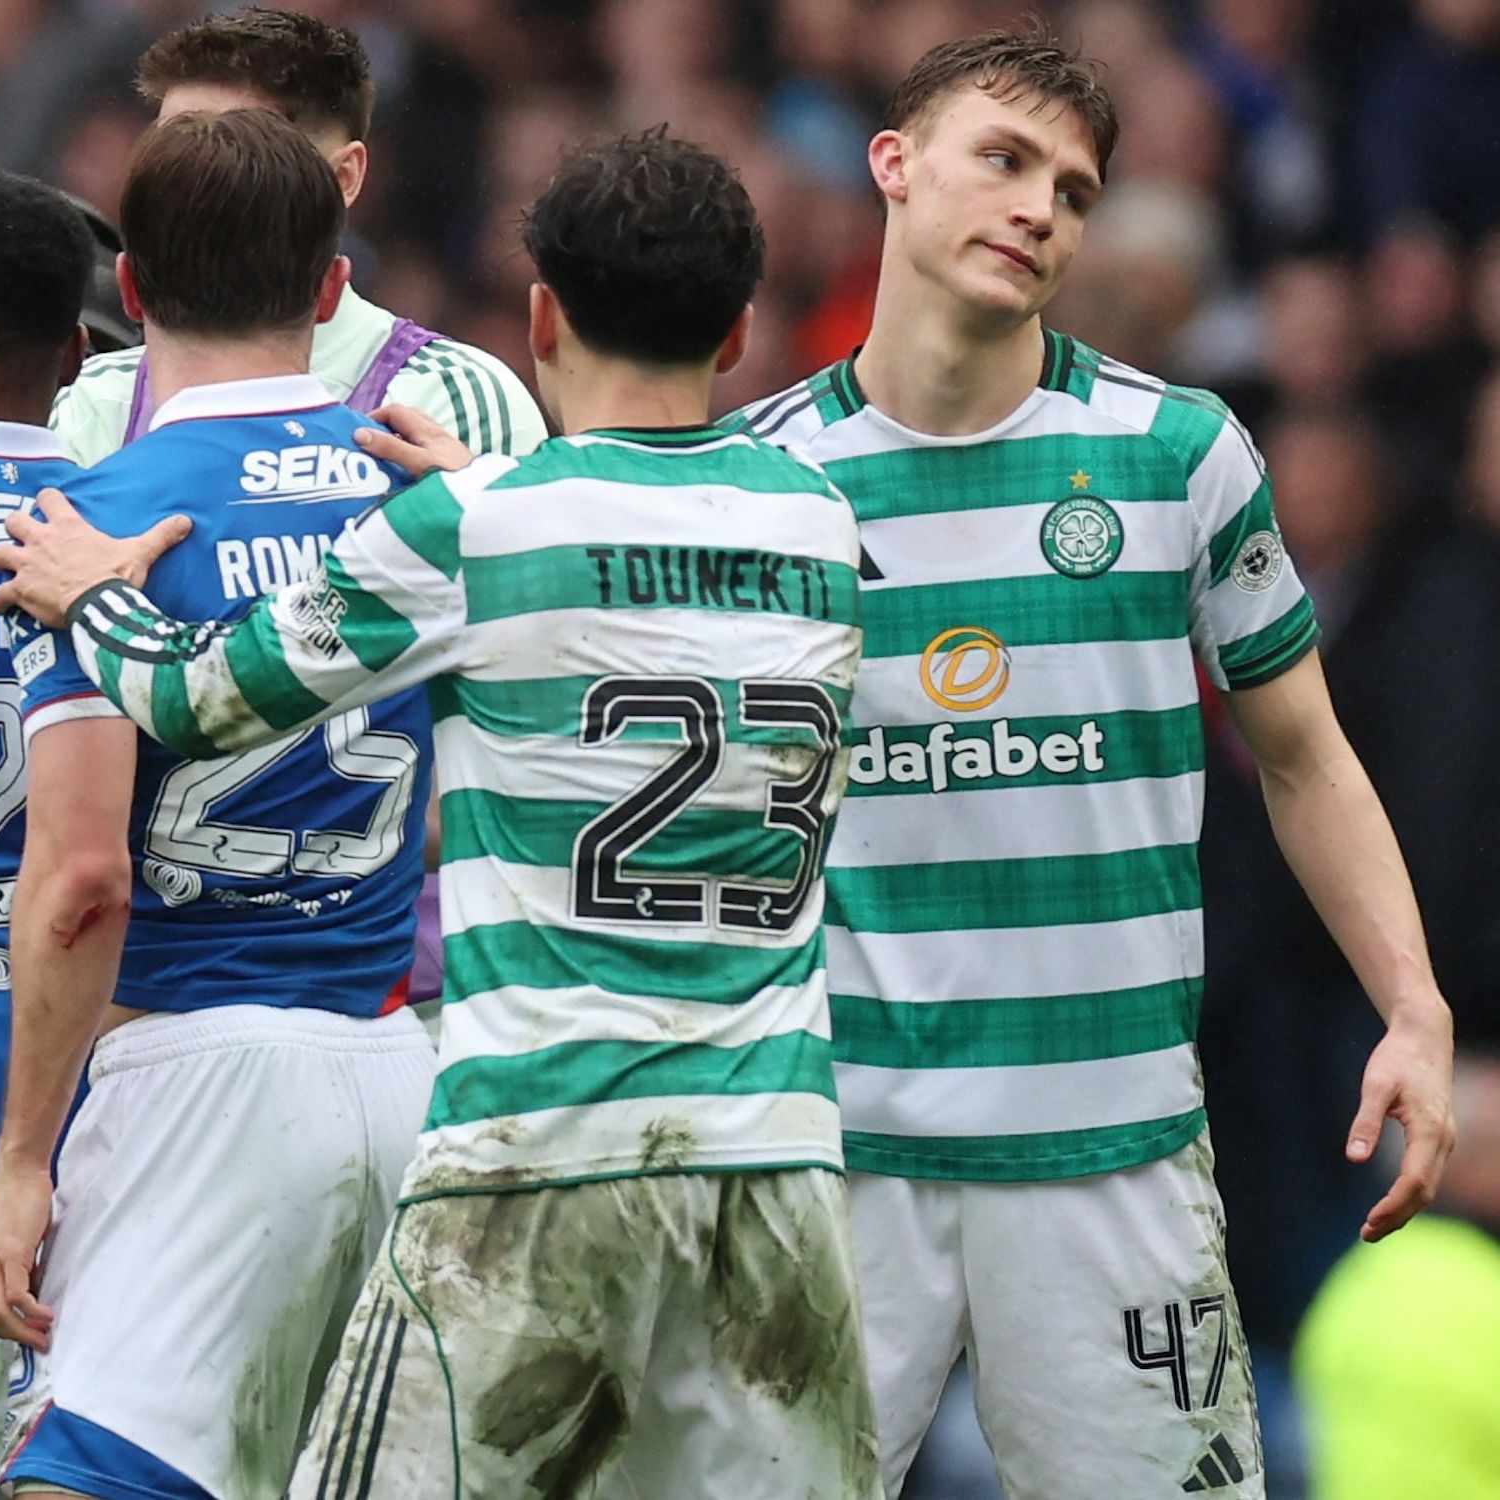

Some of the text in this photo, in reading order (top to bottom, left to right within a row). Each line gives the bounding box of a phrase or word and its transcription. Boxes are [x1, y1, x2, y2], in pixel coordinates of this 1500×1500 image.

[240, 445, 381, 494] SEKO
[586, 548, 831, 619] TOUNEKTI
[848, 718, 1105, 793] dafabet
[571, 674, 841, 933] 23
[1121, 1293, 1229, 1414] 47
